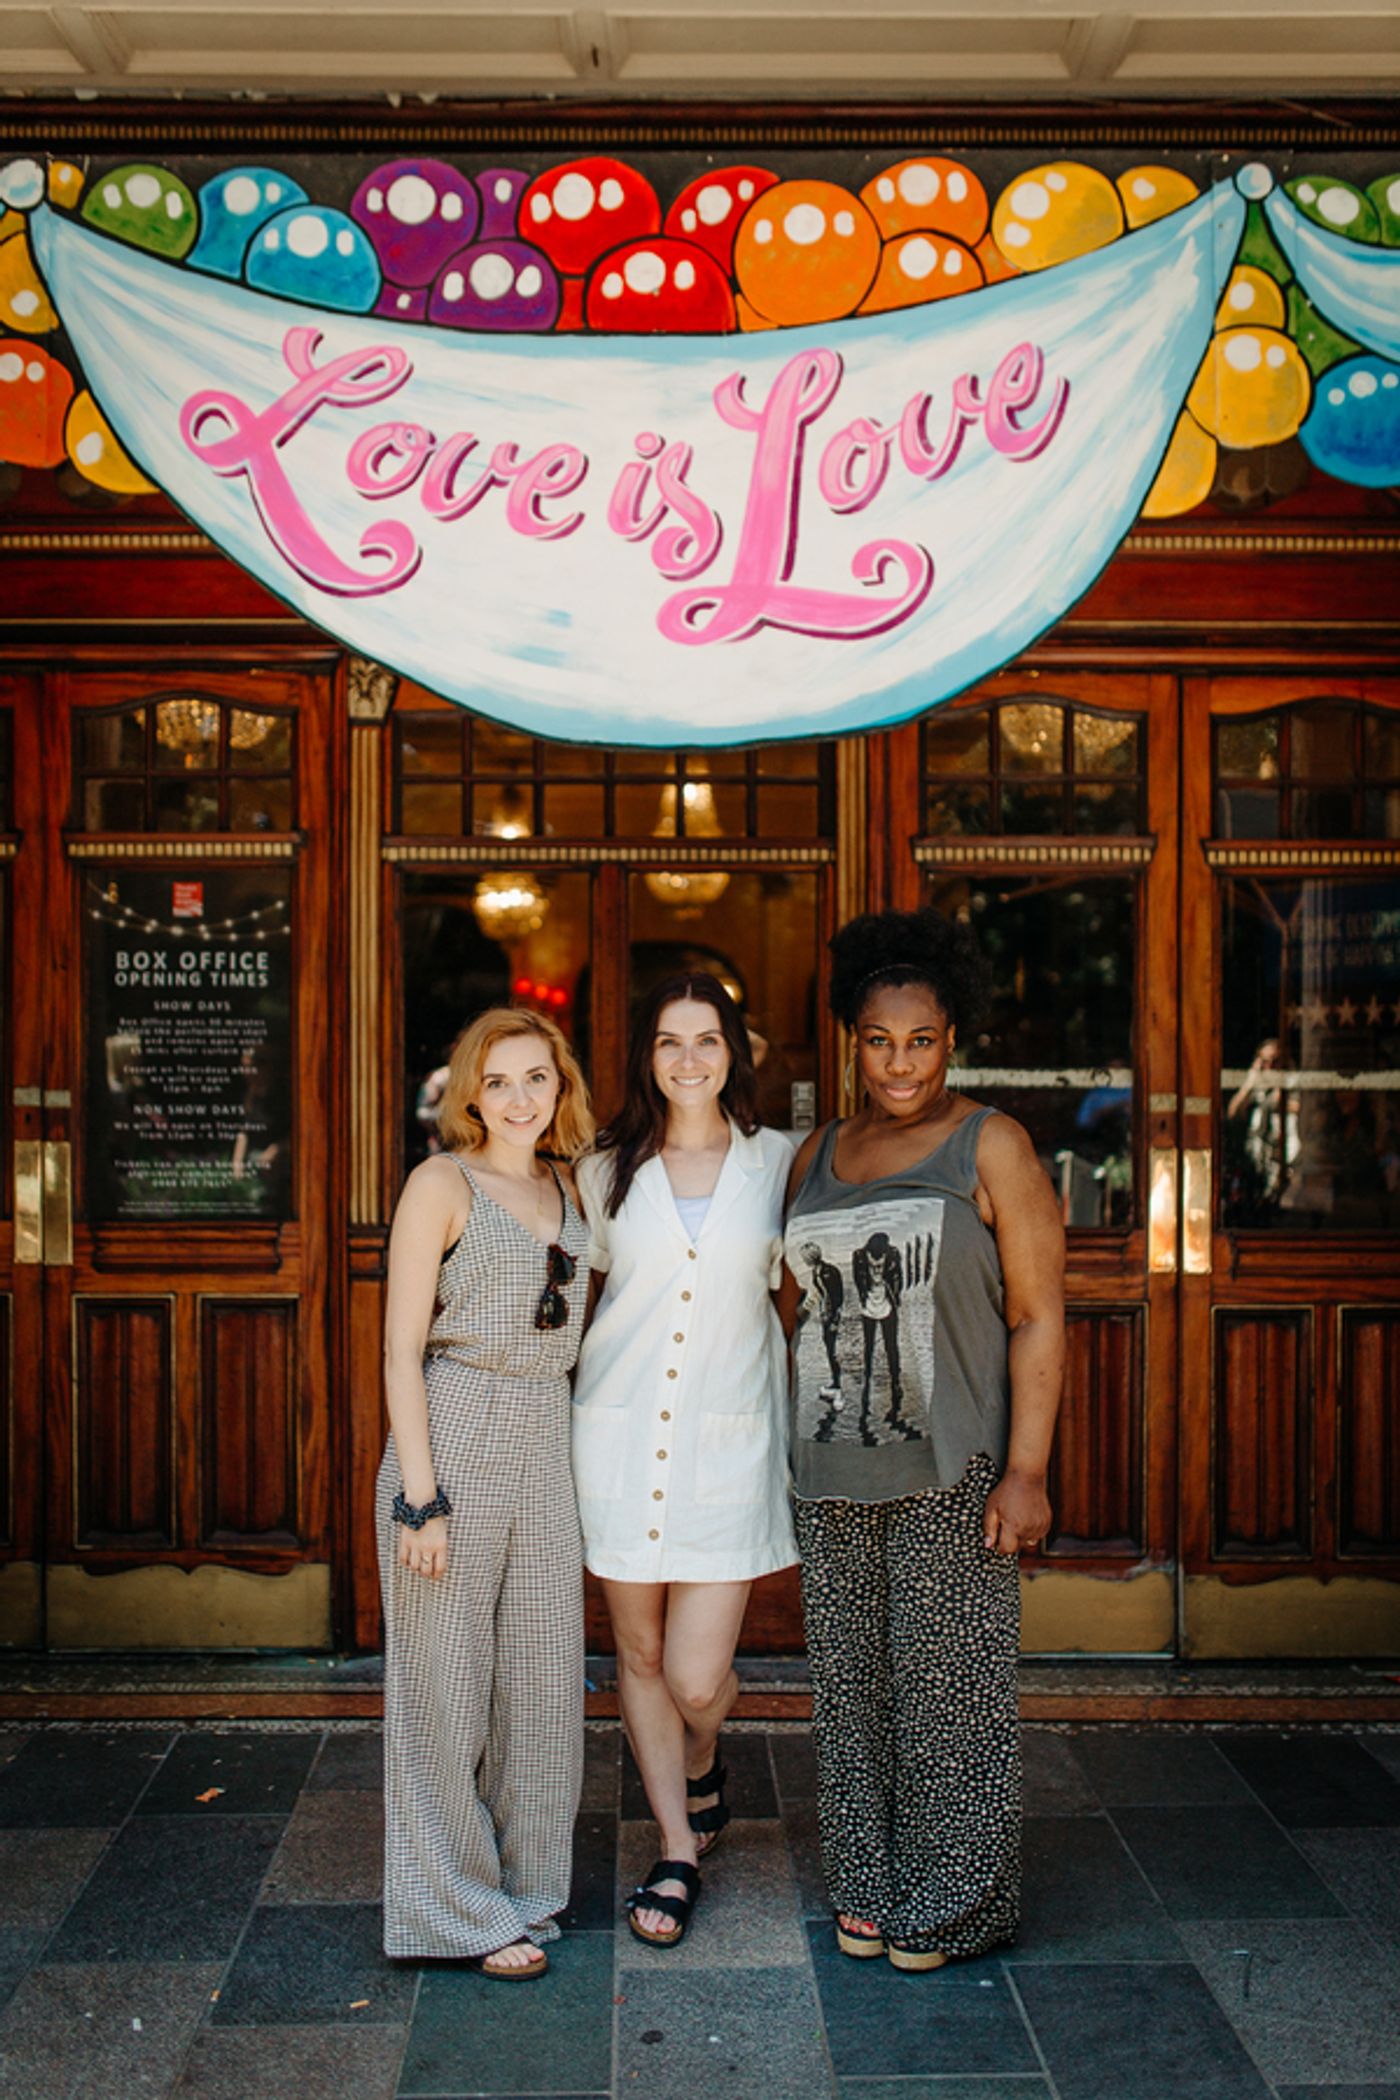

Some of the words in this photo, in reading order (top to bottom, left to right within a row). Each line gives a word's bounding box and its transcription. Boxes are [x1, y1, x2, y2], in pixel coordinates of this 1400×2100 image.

[179, 327, 590, 598] Love
[656, 342, 1070, 645] Love
[607, 431, 723, 581] is
[115, 951, 168, 970] BOX
[179, 951, 269, 970] OFFICE
[114, 972, 202, 987] OPENING
[210, 972, 269, 987] TIMES
[153, 1000, 193, 1011] SHOW
[197, 1000, 231, 1011] DAYS
[133, 1104, 163, 1115] NON
[167, 1104, 206, 1115] SHOW
[212, 1104, 245, 1115] DAYS
